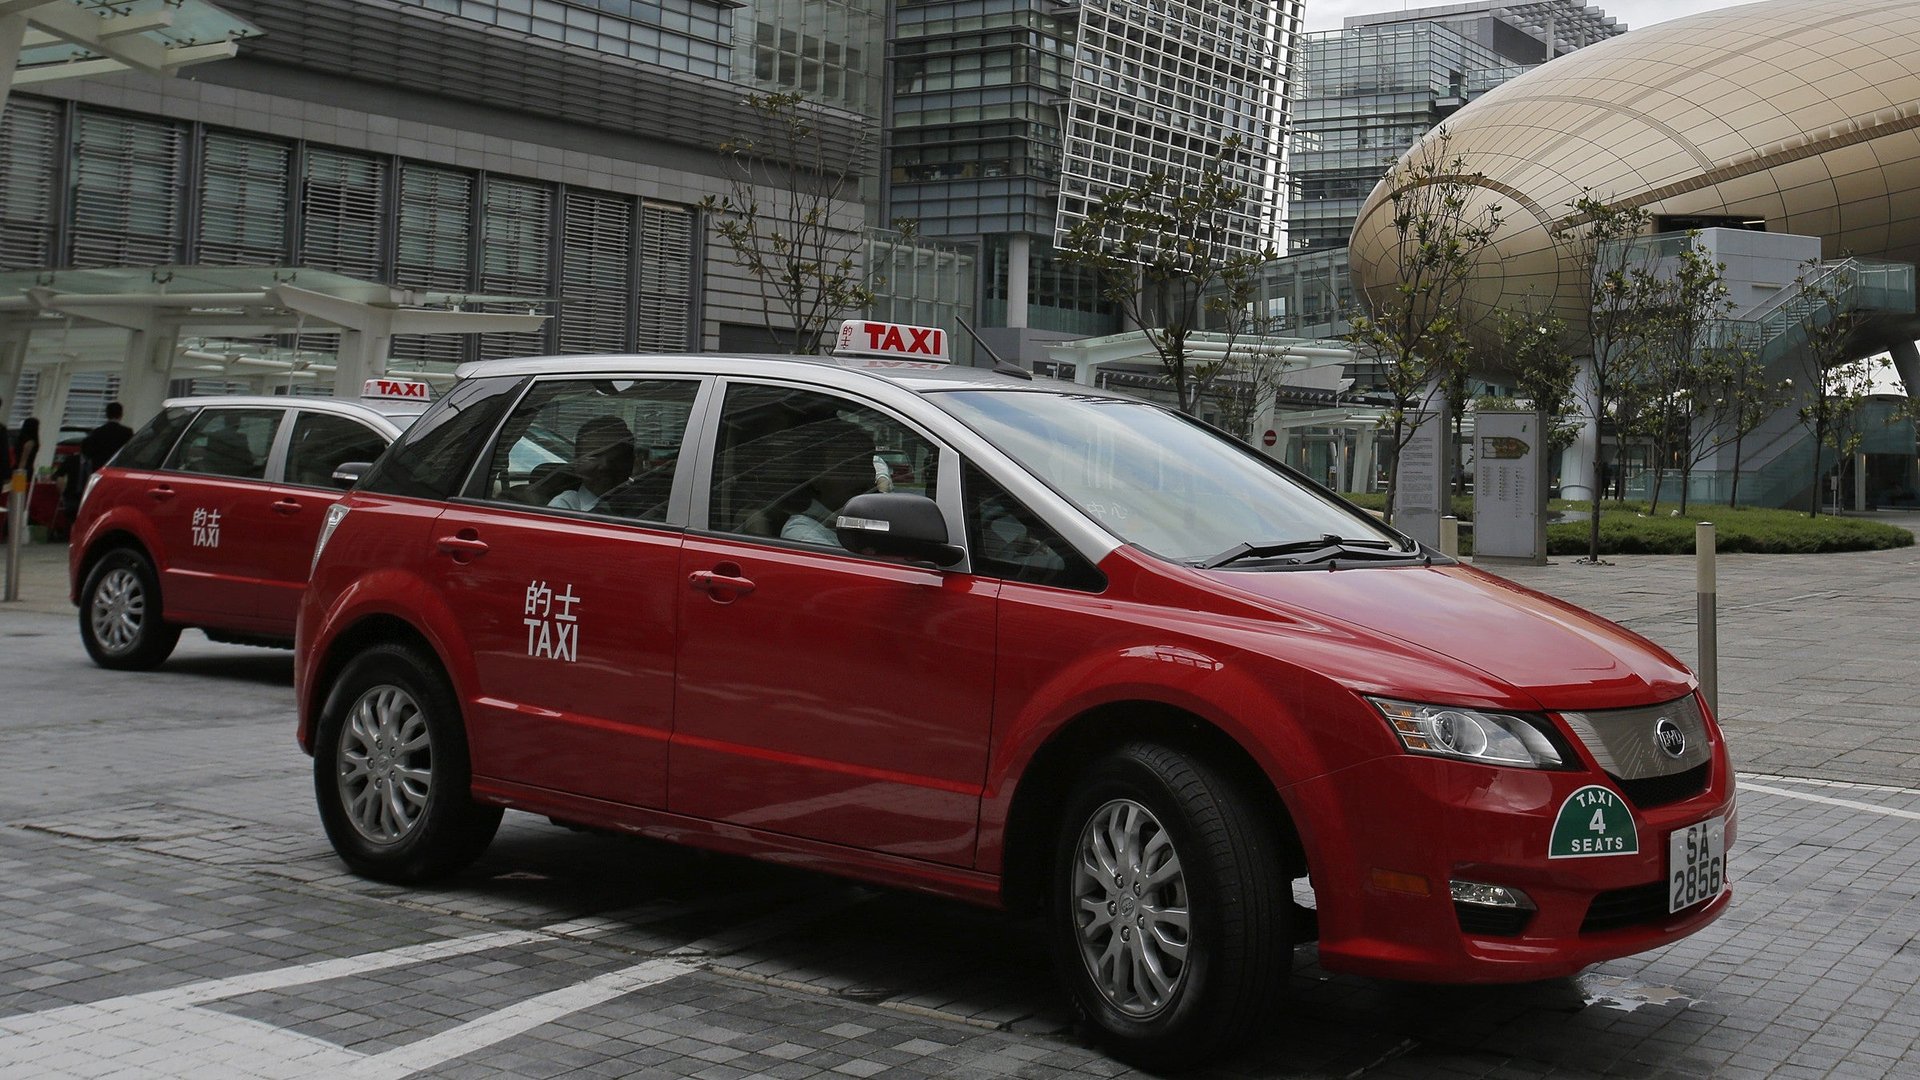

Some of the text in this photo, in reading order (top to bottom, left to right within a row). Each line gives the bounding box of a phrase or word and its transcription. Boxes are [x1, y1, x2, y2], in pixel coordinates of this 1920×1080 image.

[841, 326, 853, 349] 的士
[864, 323, 941, 355] TAXI
[377, 381, 425, 397] TAXI
[192, 508, 221, 527] 的士
[191, 527, 219, 548] TAXI
[525, 580, 580, 621] 的士
[523, 618, 578, 662] TAXI
[1661, 730, 1683, 746] BYD
[1576, 791, 1612, 808] TAXI
[1589, 808, 1606, 834] 4
[1571, 837, 1623, 852] SEATS
[1686, 823, 1709, 865] SA
[1673, 857, 1720, 910] 2856
